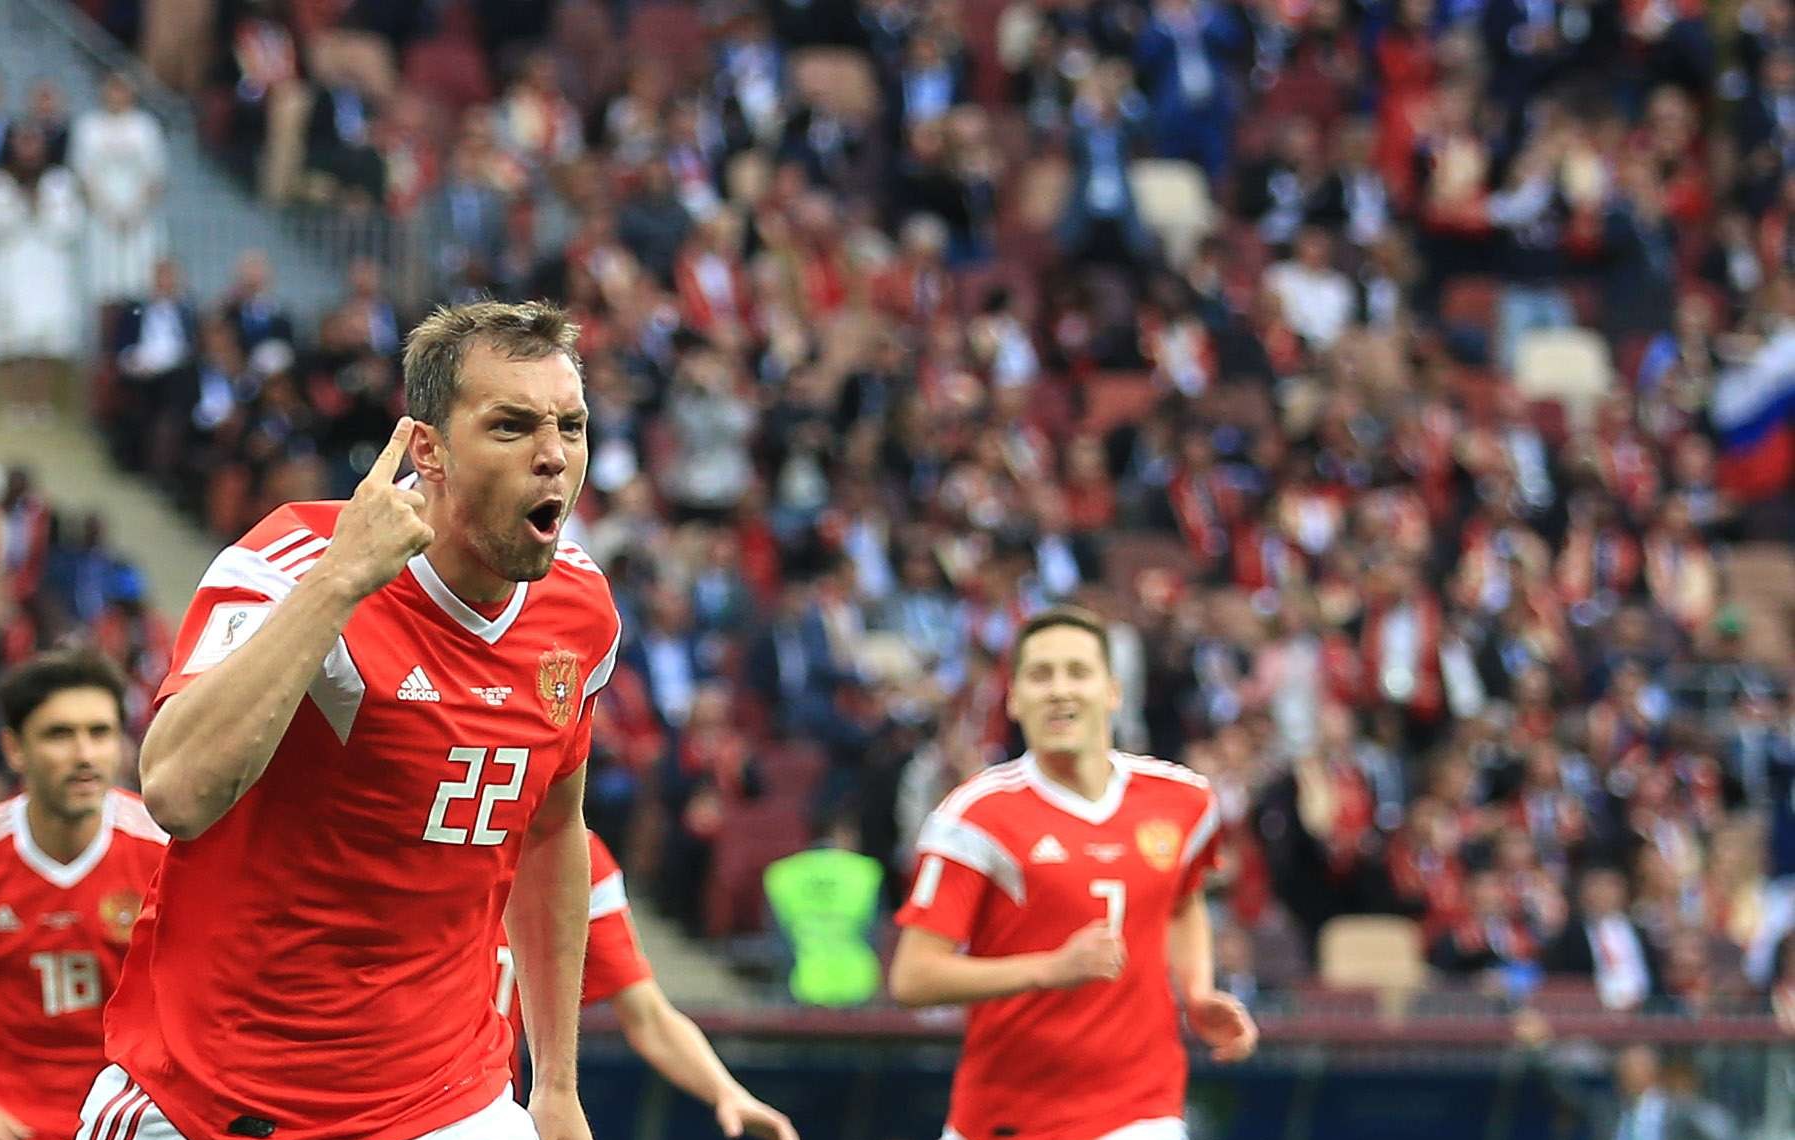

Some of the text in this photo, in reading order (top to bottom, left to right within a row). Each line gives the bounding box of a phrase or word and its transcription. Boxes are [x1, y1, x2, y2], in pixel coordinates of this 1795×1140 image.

[396, 688, 441, 702] adidas
[423, 747, 530, 845] 22
[29, 952, 101, 1016] 18
